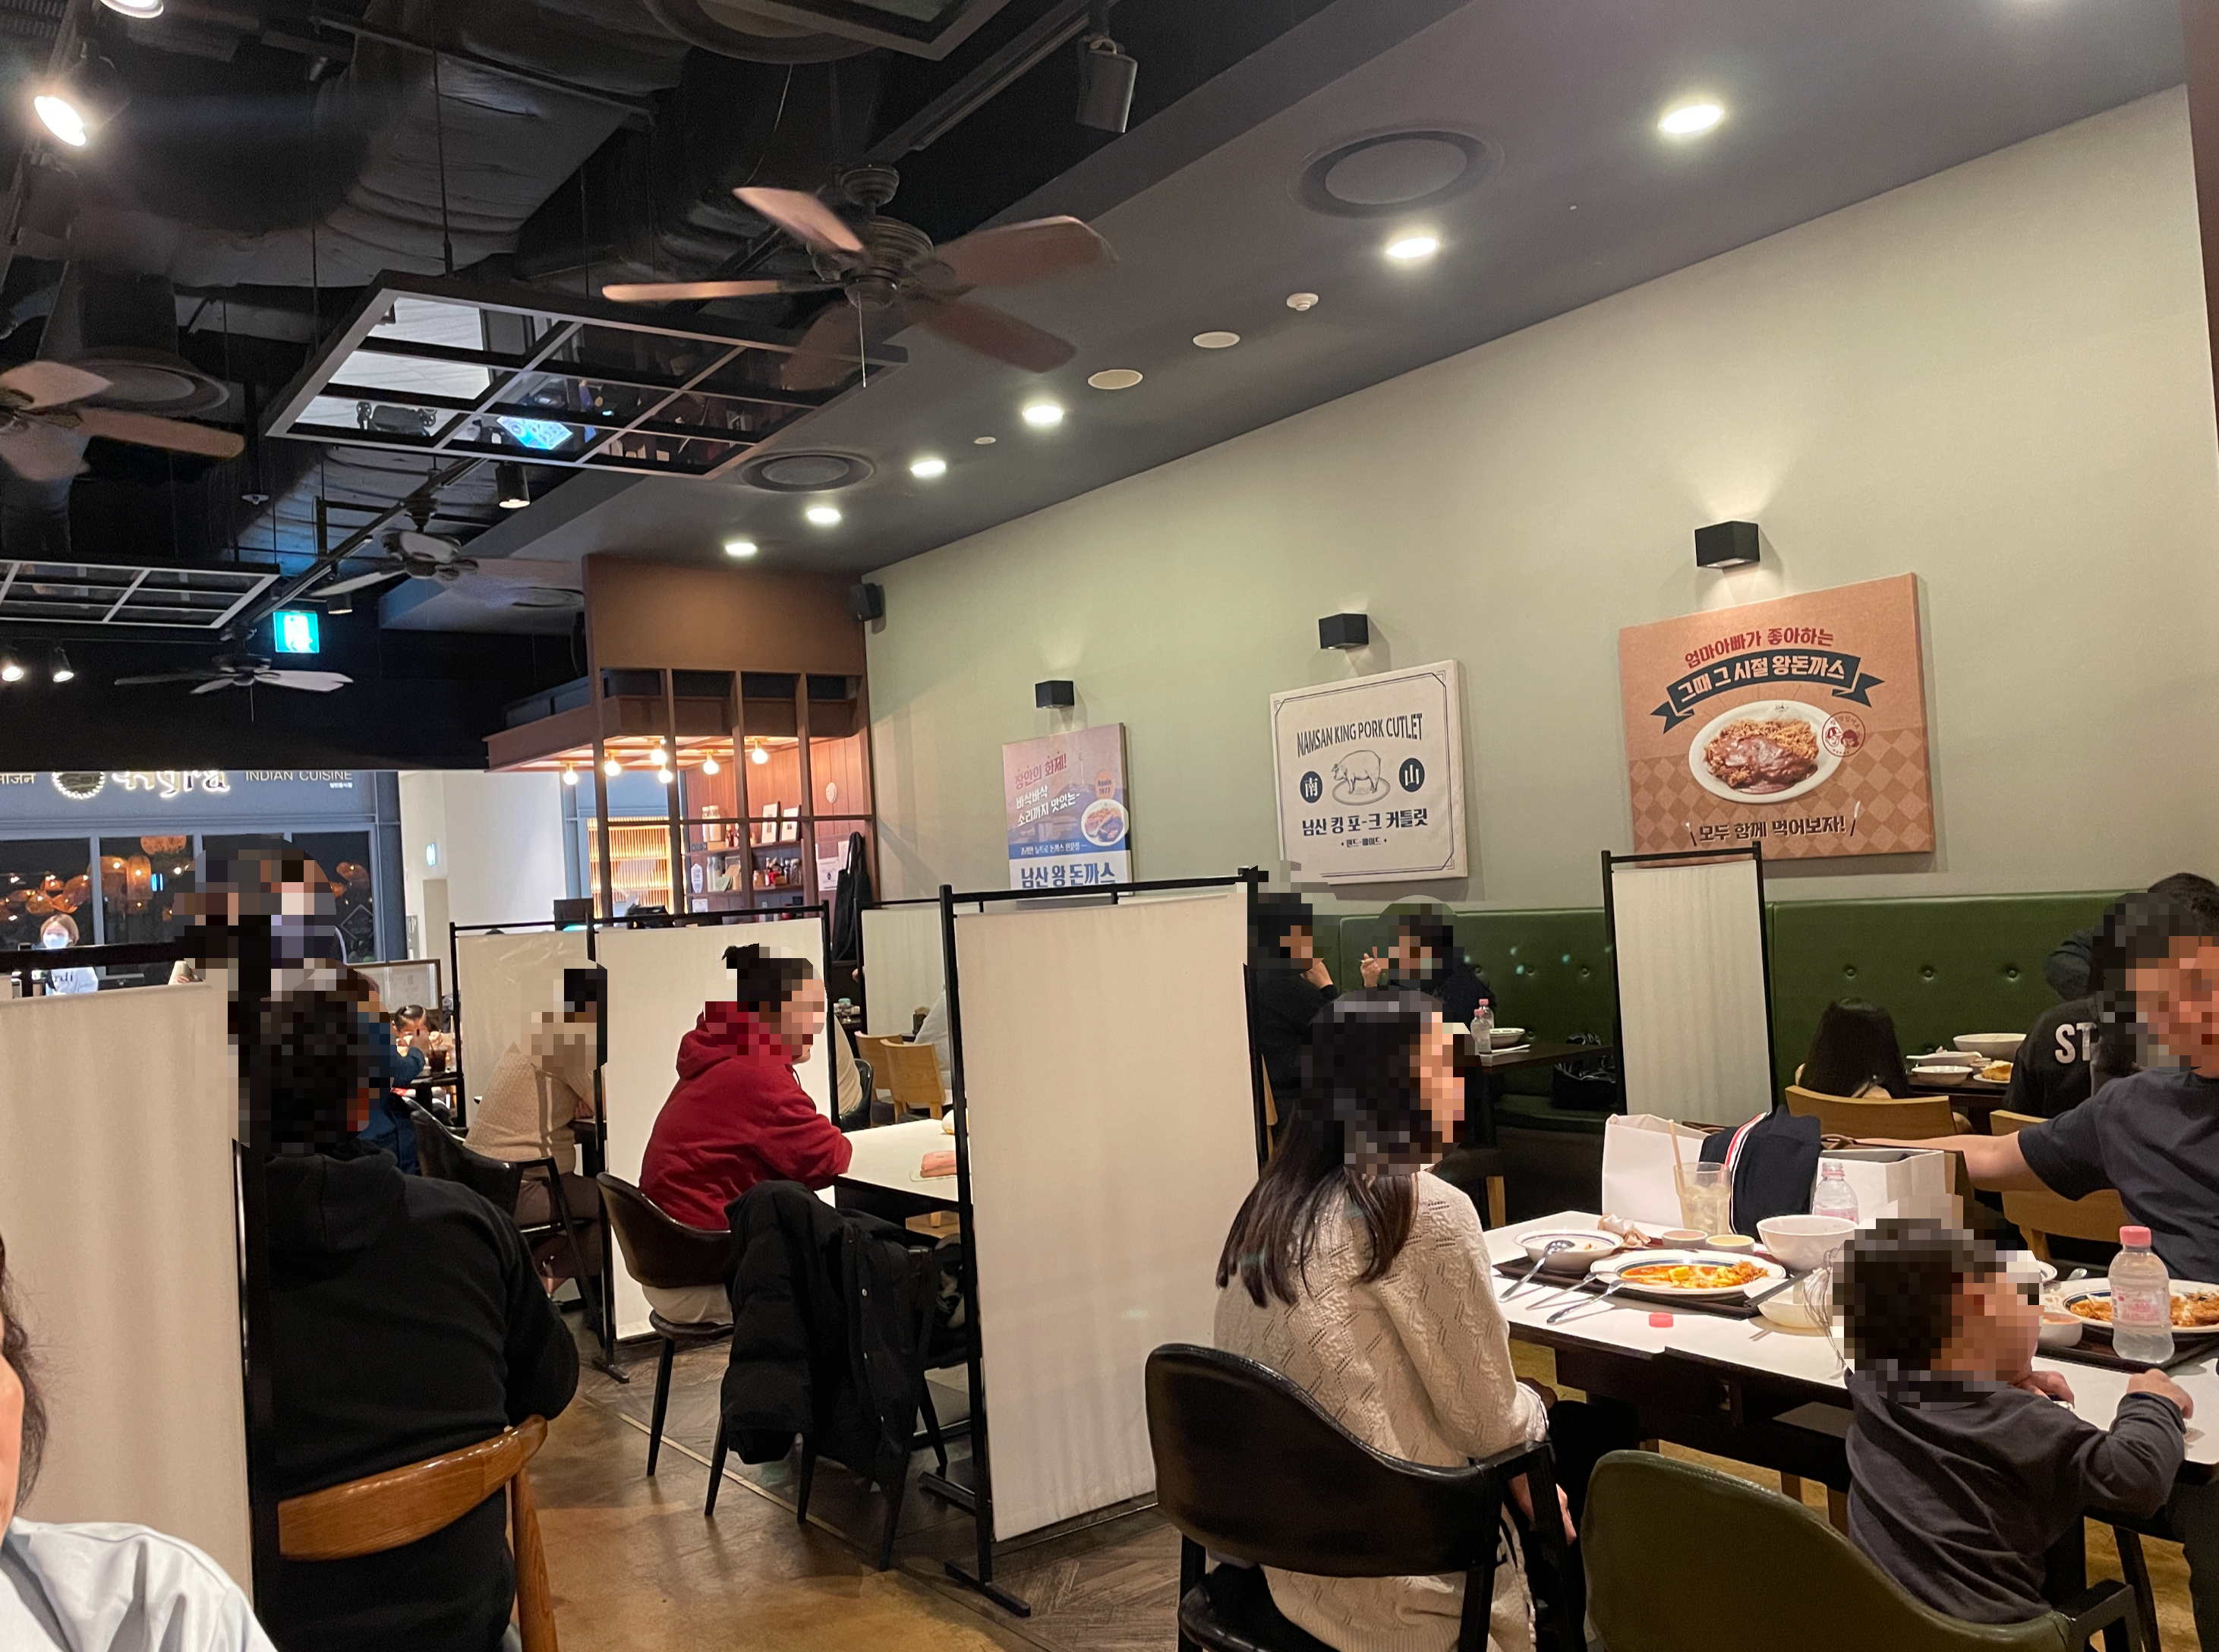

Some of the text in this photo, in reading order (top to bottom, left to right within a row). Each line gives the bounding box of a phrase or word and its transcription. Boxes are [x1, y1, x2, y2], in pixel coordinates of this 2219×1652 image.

[1685, 627, 1833, 669] 엄마아빠가 좋아하는
[1678, 655, 1845, 703] 그때 그 시절 왕돈까스
[1297, 713, 1423, 758] NAMSAN KING PORK CUTLET
[245, 771, 352, 781] INDIAN CUISINE
[1015, 754, 1067, 790] 장안의 화제!
[1404, 765, 1420, 787] 山
[1016, 785, 1048, 809] 바삭바삭
[1303, 777, 1319, 798] 南
[1017, 805, 1049, 827] 소리까지
[1302, 809, 1428, 837] 남산 킹 포-크 커틀릿
[1699, 816, 1846, 841] 모두 함께 먹어보자!
[1021, 862, 1115, 889] 남산 왕 돈까스
